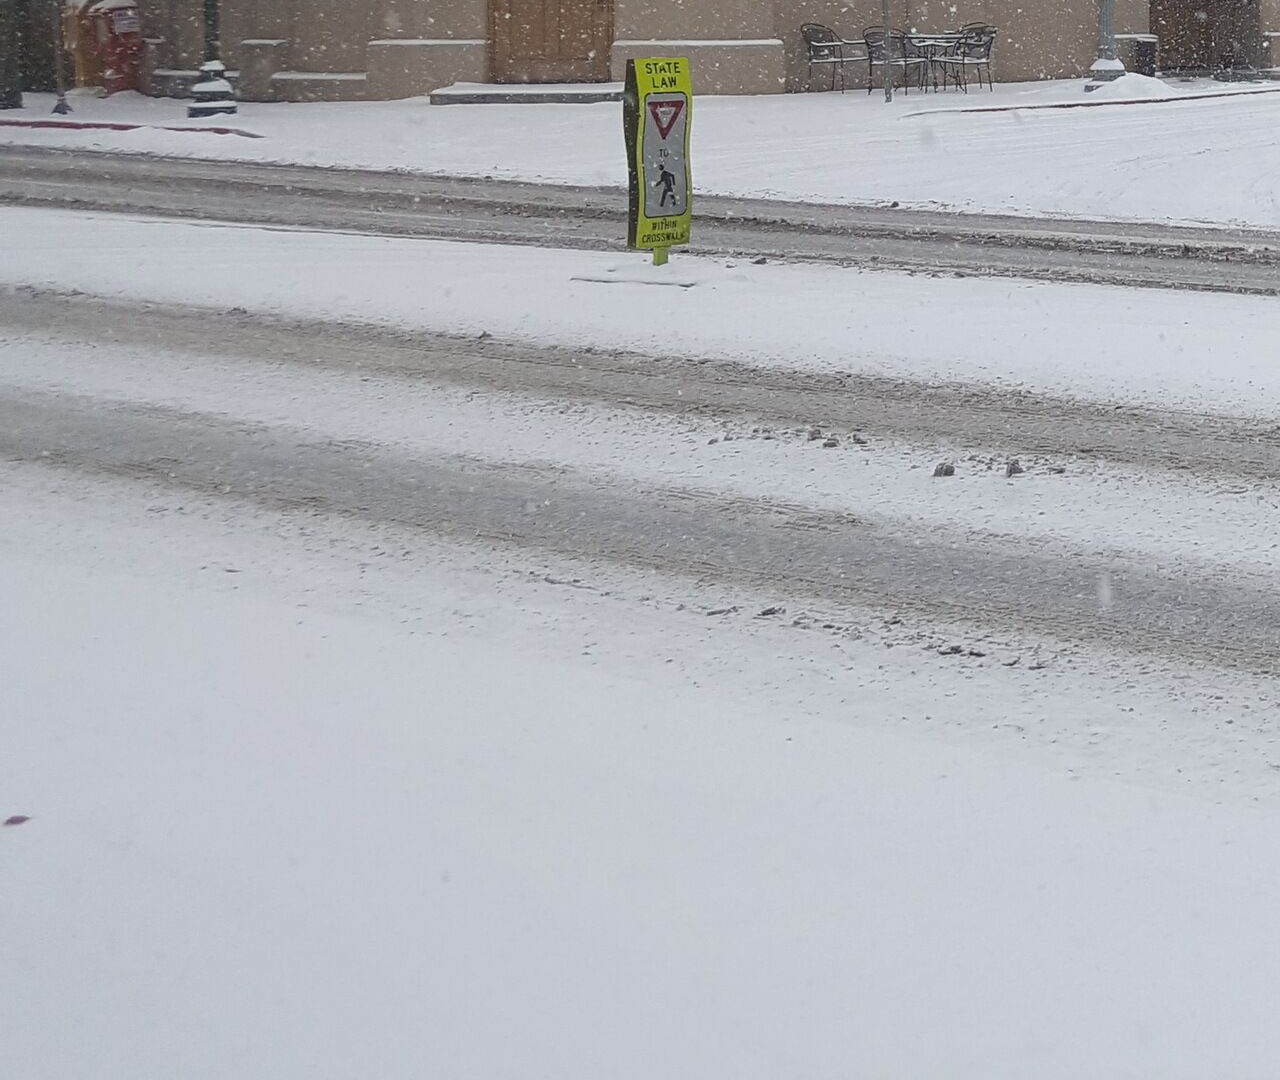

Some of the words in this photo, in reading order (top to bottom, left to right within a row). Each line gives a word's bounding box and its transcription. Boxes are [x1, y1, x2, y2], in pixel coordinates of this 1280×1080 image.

[645, 61, 681, 75] STATE
[652, 76, 678, 89] LAW
[658, 147, 670, 158] TO
[651, 220, 677, 231] WITHIN
